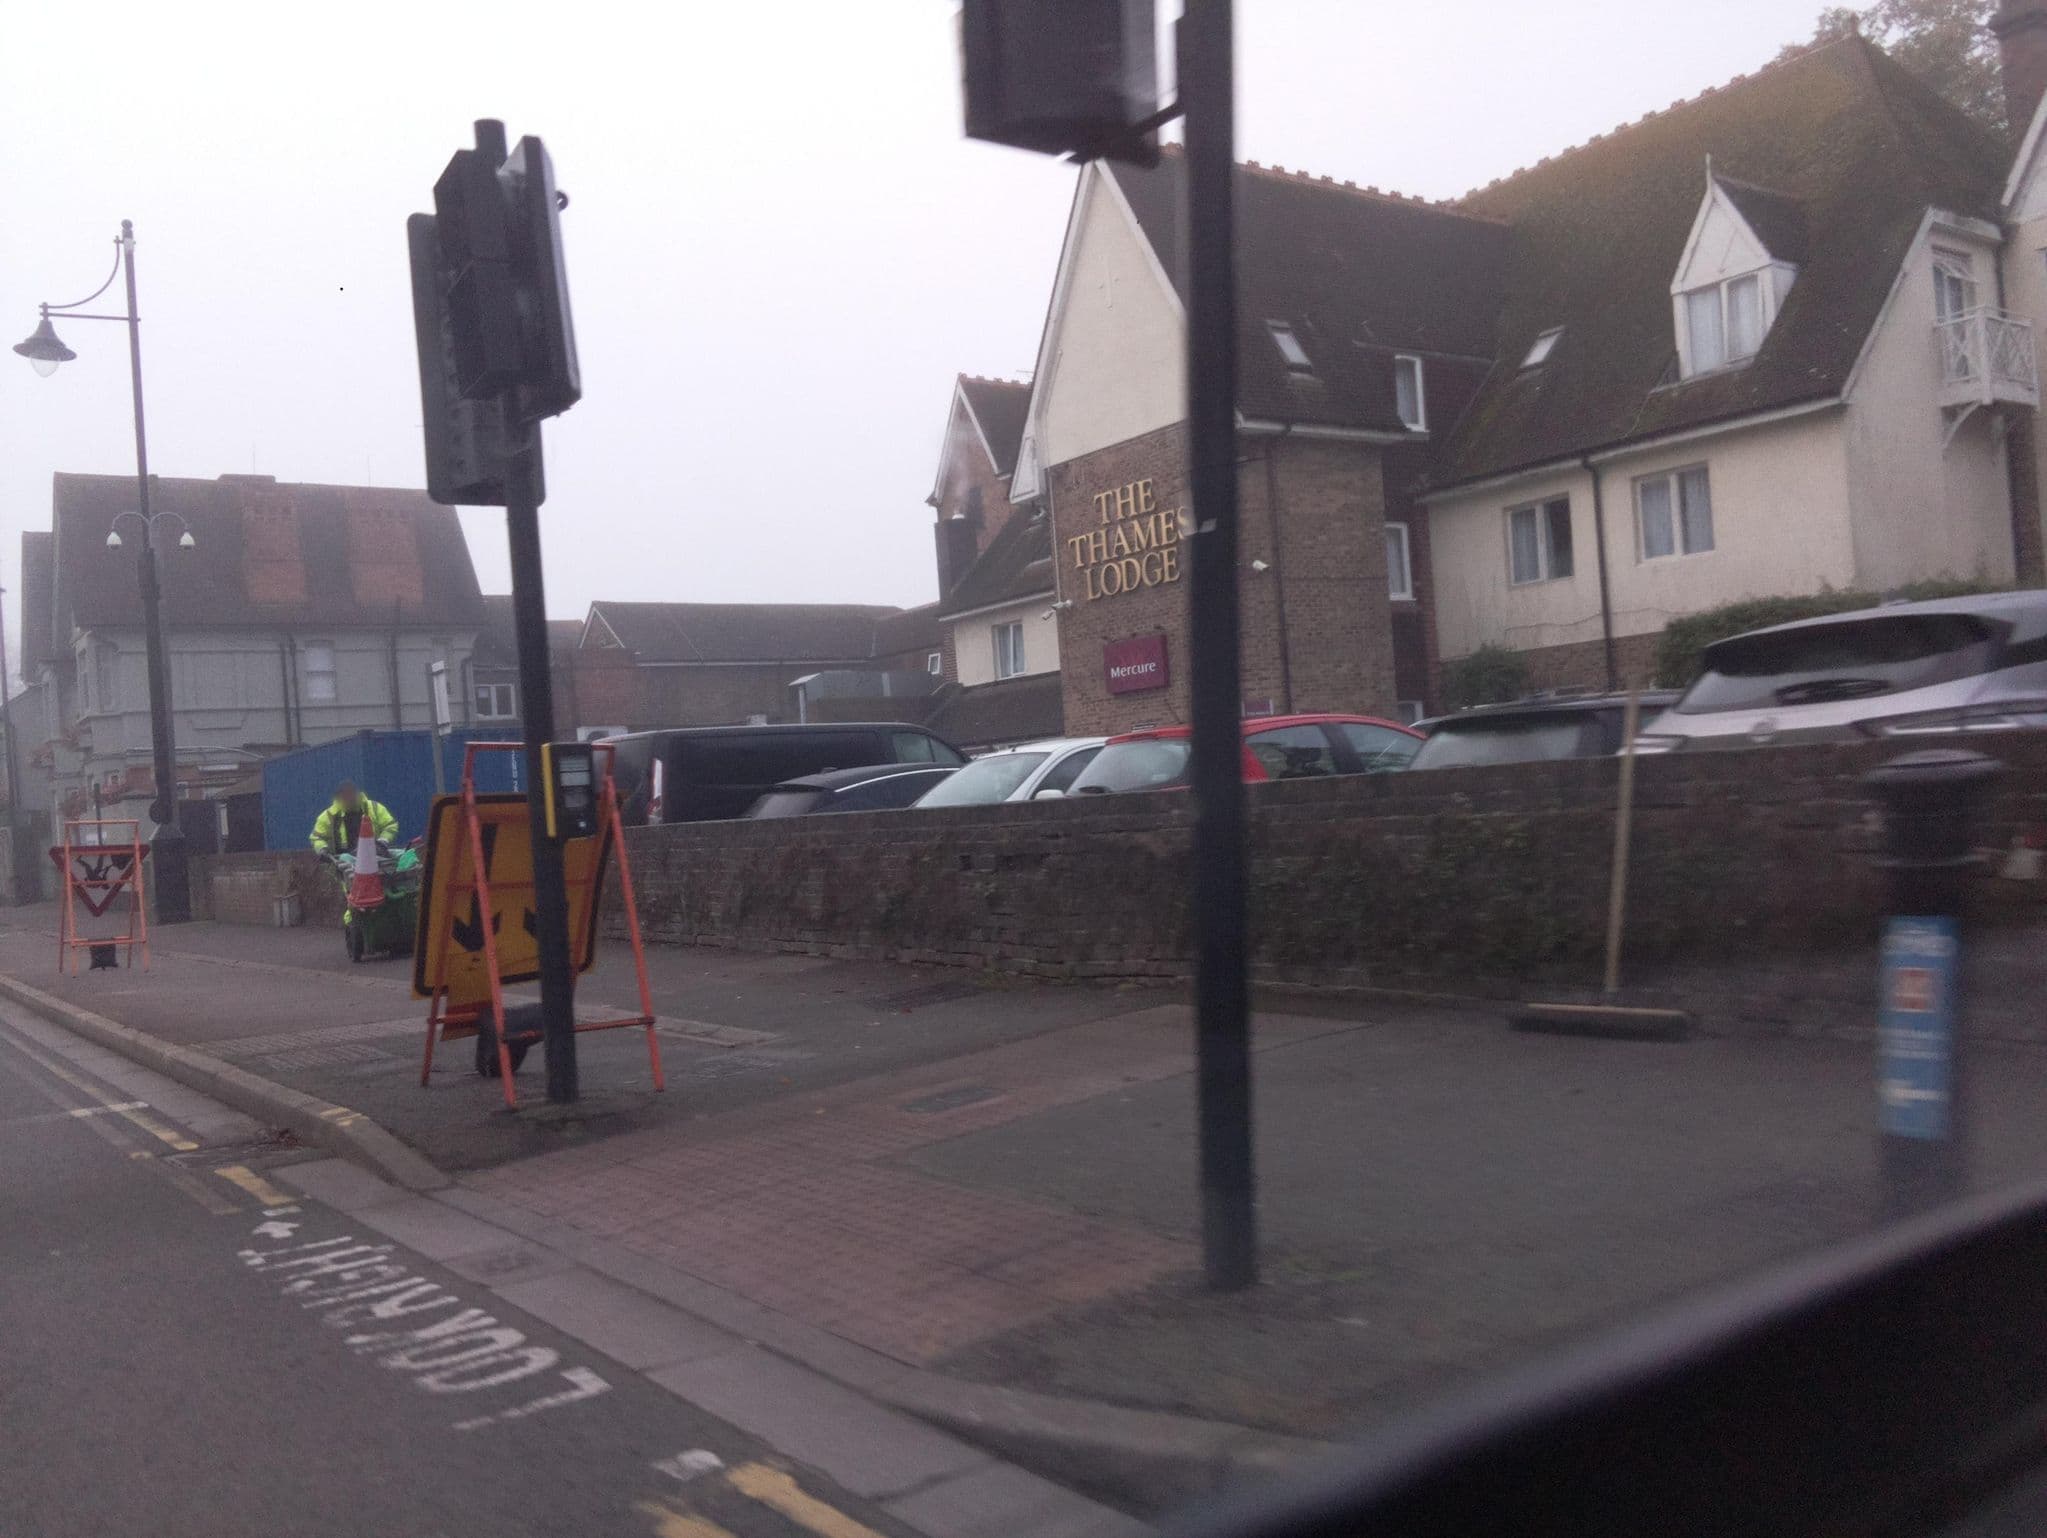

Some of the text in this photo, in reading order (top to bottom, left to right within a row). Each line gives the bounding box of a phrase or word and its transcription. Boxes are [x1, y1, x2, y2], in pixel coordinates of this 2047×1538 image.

[1093, 478, 1156, 525] THE
[1086, 547, 1181, 600] LODGE
[1110, 662, 1156, 678] Mercure
[345, 1307, 613, 1430] LOOK
